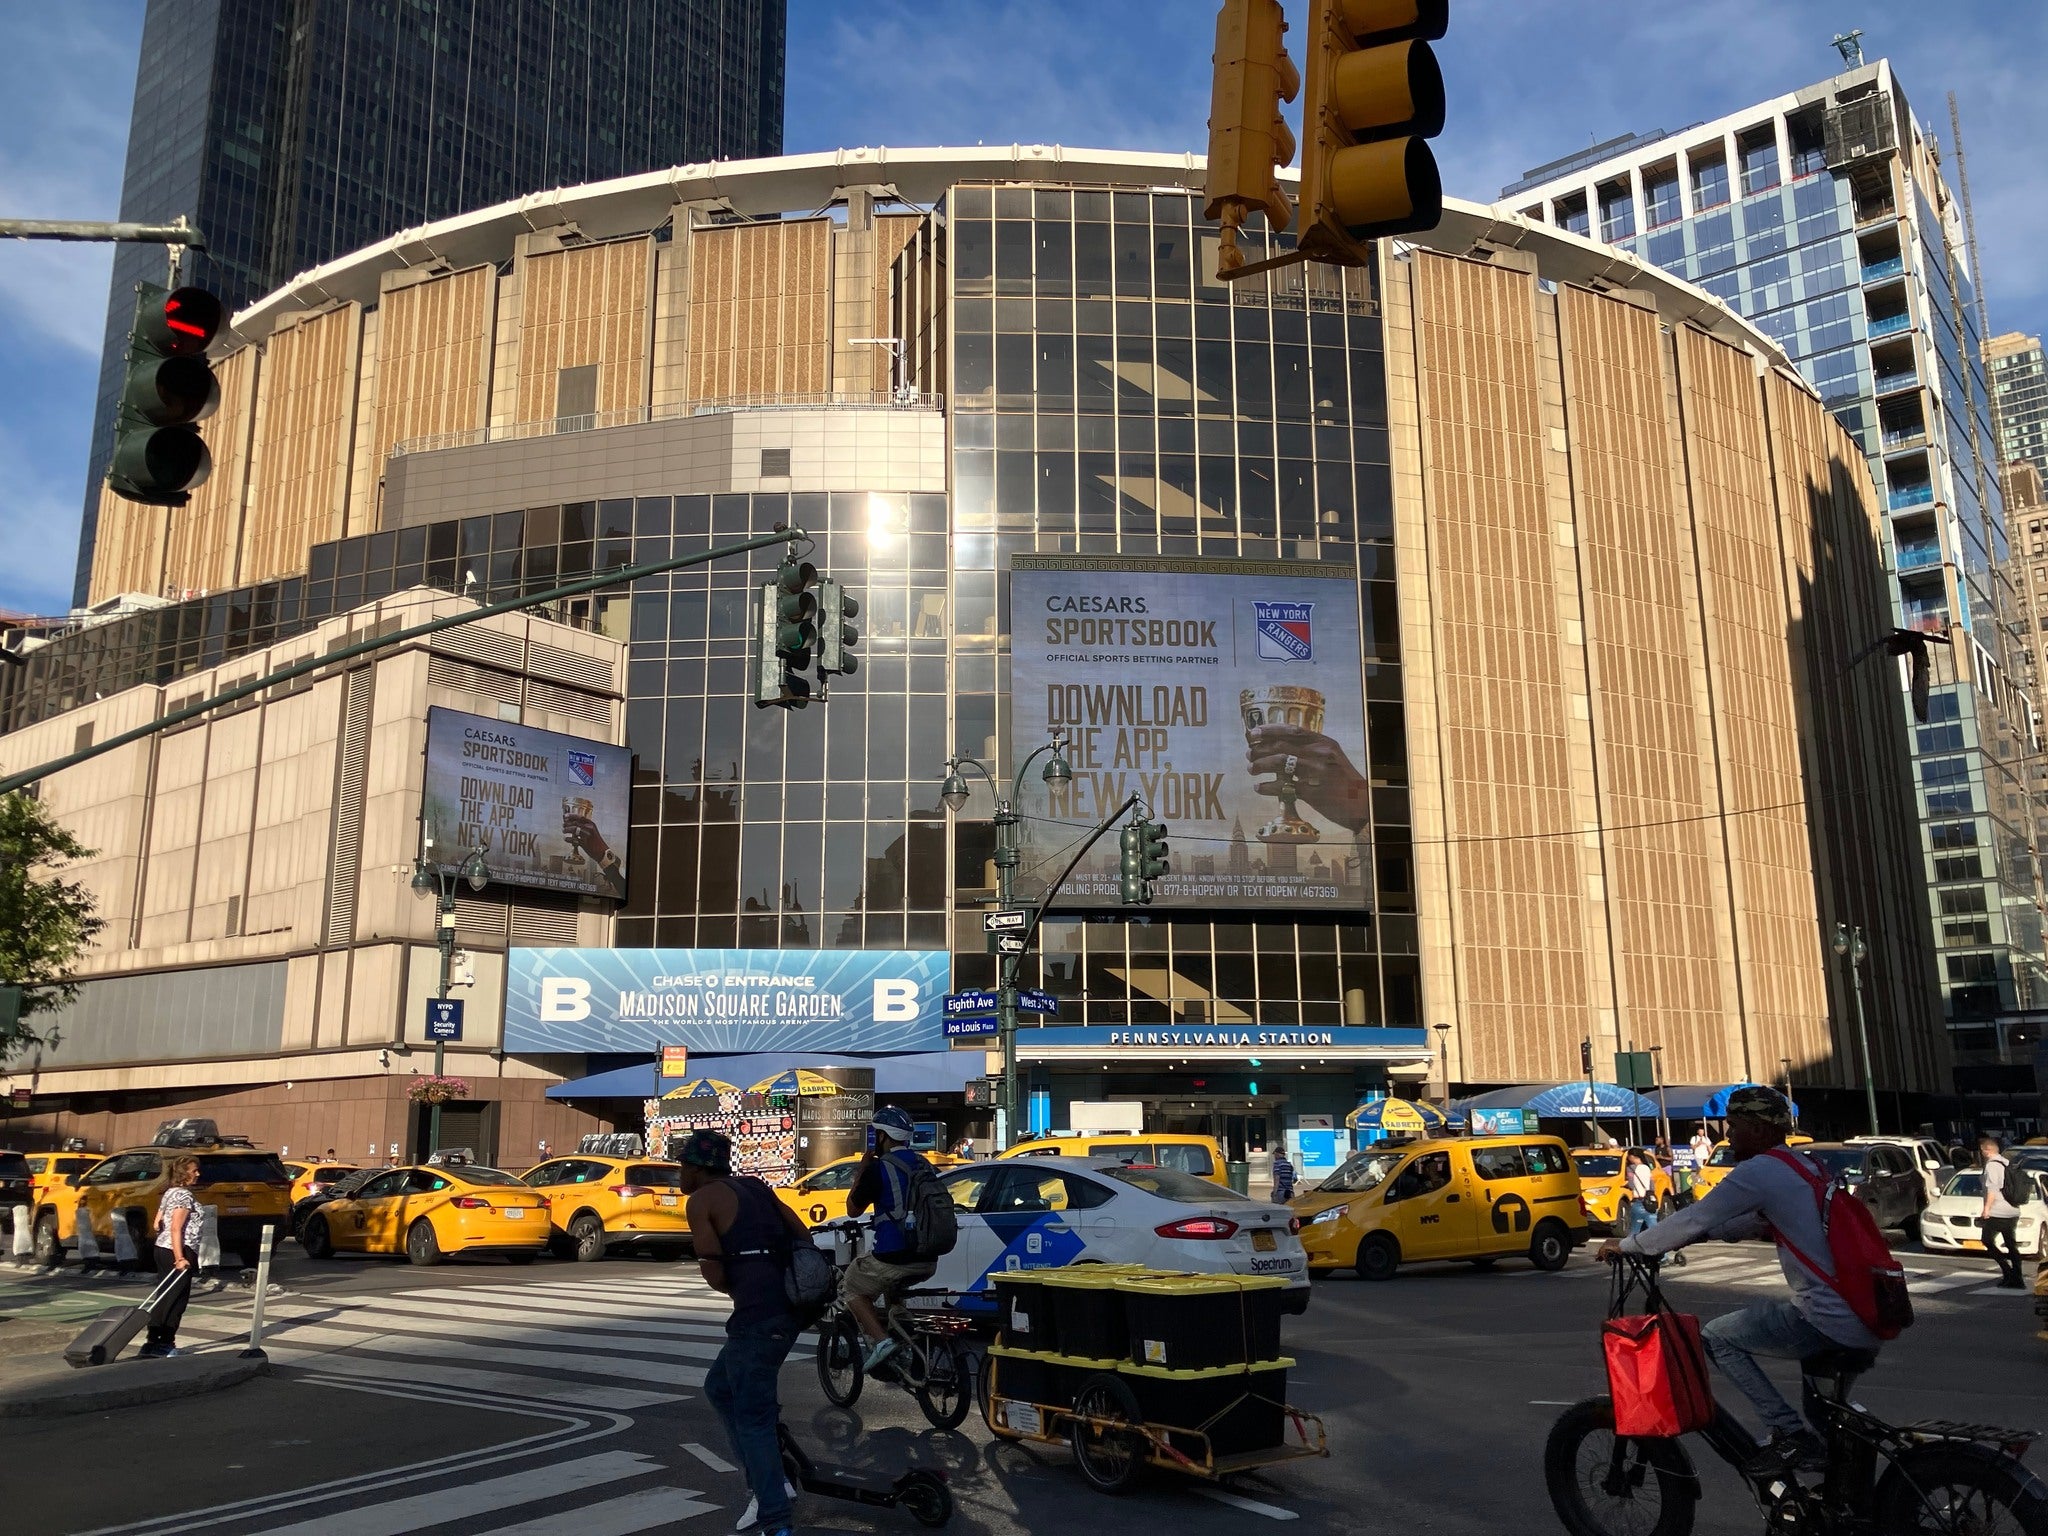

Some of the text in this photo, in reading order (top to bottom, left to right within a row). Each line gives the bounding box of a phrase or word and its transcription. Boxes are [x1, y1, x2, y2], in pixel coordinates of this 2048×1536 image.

[1258, 609, 1308, 620] NEW YORK
[1046, 618, 1217, 647] SPORTSBOOK
[1265, 622, 1309, 657] RANGERS
[1046, 654, 1089, 662] OFFICIAL
[1092, 655, 1130, 663] SPORTS
[1176, 657, 1219, 665] PARTNER
[1047, 684, 1208, 727] DOWNLOAD
[462, 741, 549, 772] SPORTSBOOK
[1113, 728, 1172, 775] APP,
[461, 776, 533, 809] DOWNLOAD
[1139, 771, 1227, 820] YORK
[460, 799, 485, 824] THE
[458, 822, 538, 858] NEW YORK
[1164, 885, 1224, 896] 877-8-HOPENY
[1227, 885, 1238, 896] OR
[1243, 886, 1262, 896] TEXT
[1266, 886, 1297, 897] HOPENY
[1301, 886, 1338, 897] (467369)
[653, 976, 815, 986] CHASE ENTRANCE
[540, 977, 591, 1022] B
[620, 991, 698, 1017] MADISON
[705, 991, 770, 1018] SQUARE
[873, 978, 920, 1022] B
[948, 998, 994, 1012] Eighth Ave
[1021, 996, 1036, 1008] West
[1048, 1001, 1055, 1010] St
[433, 1021, 456, 1029] Security
[948, 1023, 960, 1033] Joe
[961, 1021, 981, 1032] Louis
[1110, 1032, 1333, 1045] PENNSYLVANIA STATION
[1582, 1088, 1600, 1105] A
[1496, 1111, 1511, 1119] GET
[1385, 1120, 1422, 1128] SABRETT
[813, 1207, 824, 1221] T
[1420, 1215, 1440, 1224] NYC
[1499, 1203, 1521, 1233] T
[1250, 1258, 1293, 1275] Spectrum
